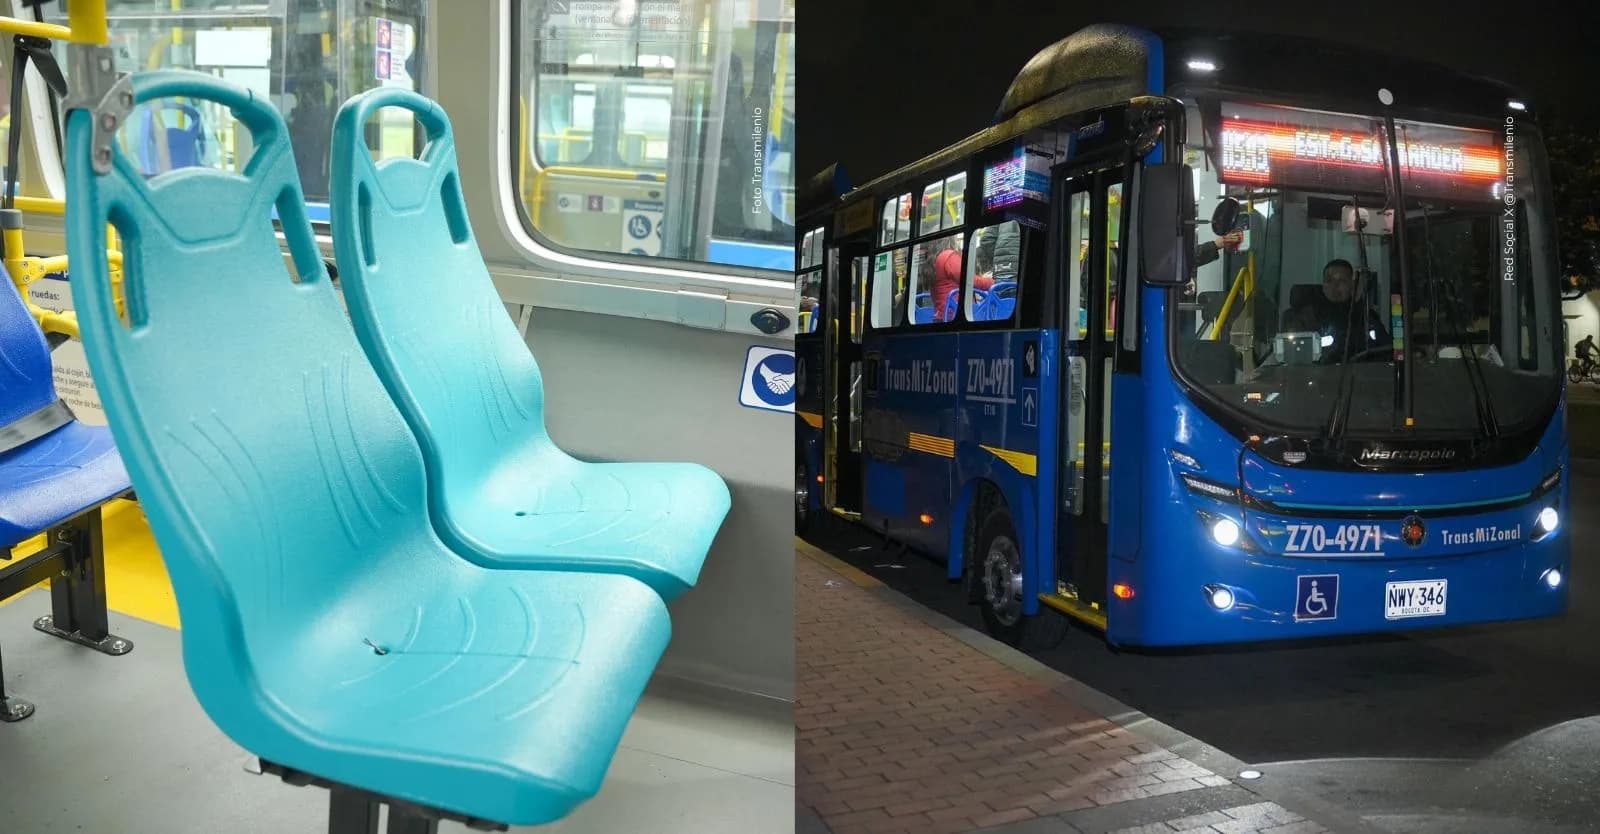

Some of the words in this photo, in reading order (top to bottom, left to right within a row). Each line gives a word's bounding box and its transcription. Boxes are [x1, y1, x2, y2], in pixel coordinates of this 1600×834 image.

[31, 290, 60, 301] ruedas:
[884, 357, 959, 395] TransMiZonal
[966, 357, 1015, 396] Z70-4971
[1360, 447, 1456, 461] Marcopolo
[1285, 524, 1382, 553] Z70-4971
[1441, 523, 1521, 546] TransMiZonal
[1389, 586, 1415, 609] NWY
[1418, 585, 1444, 607] 346
